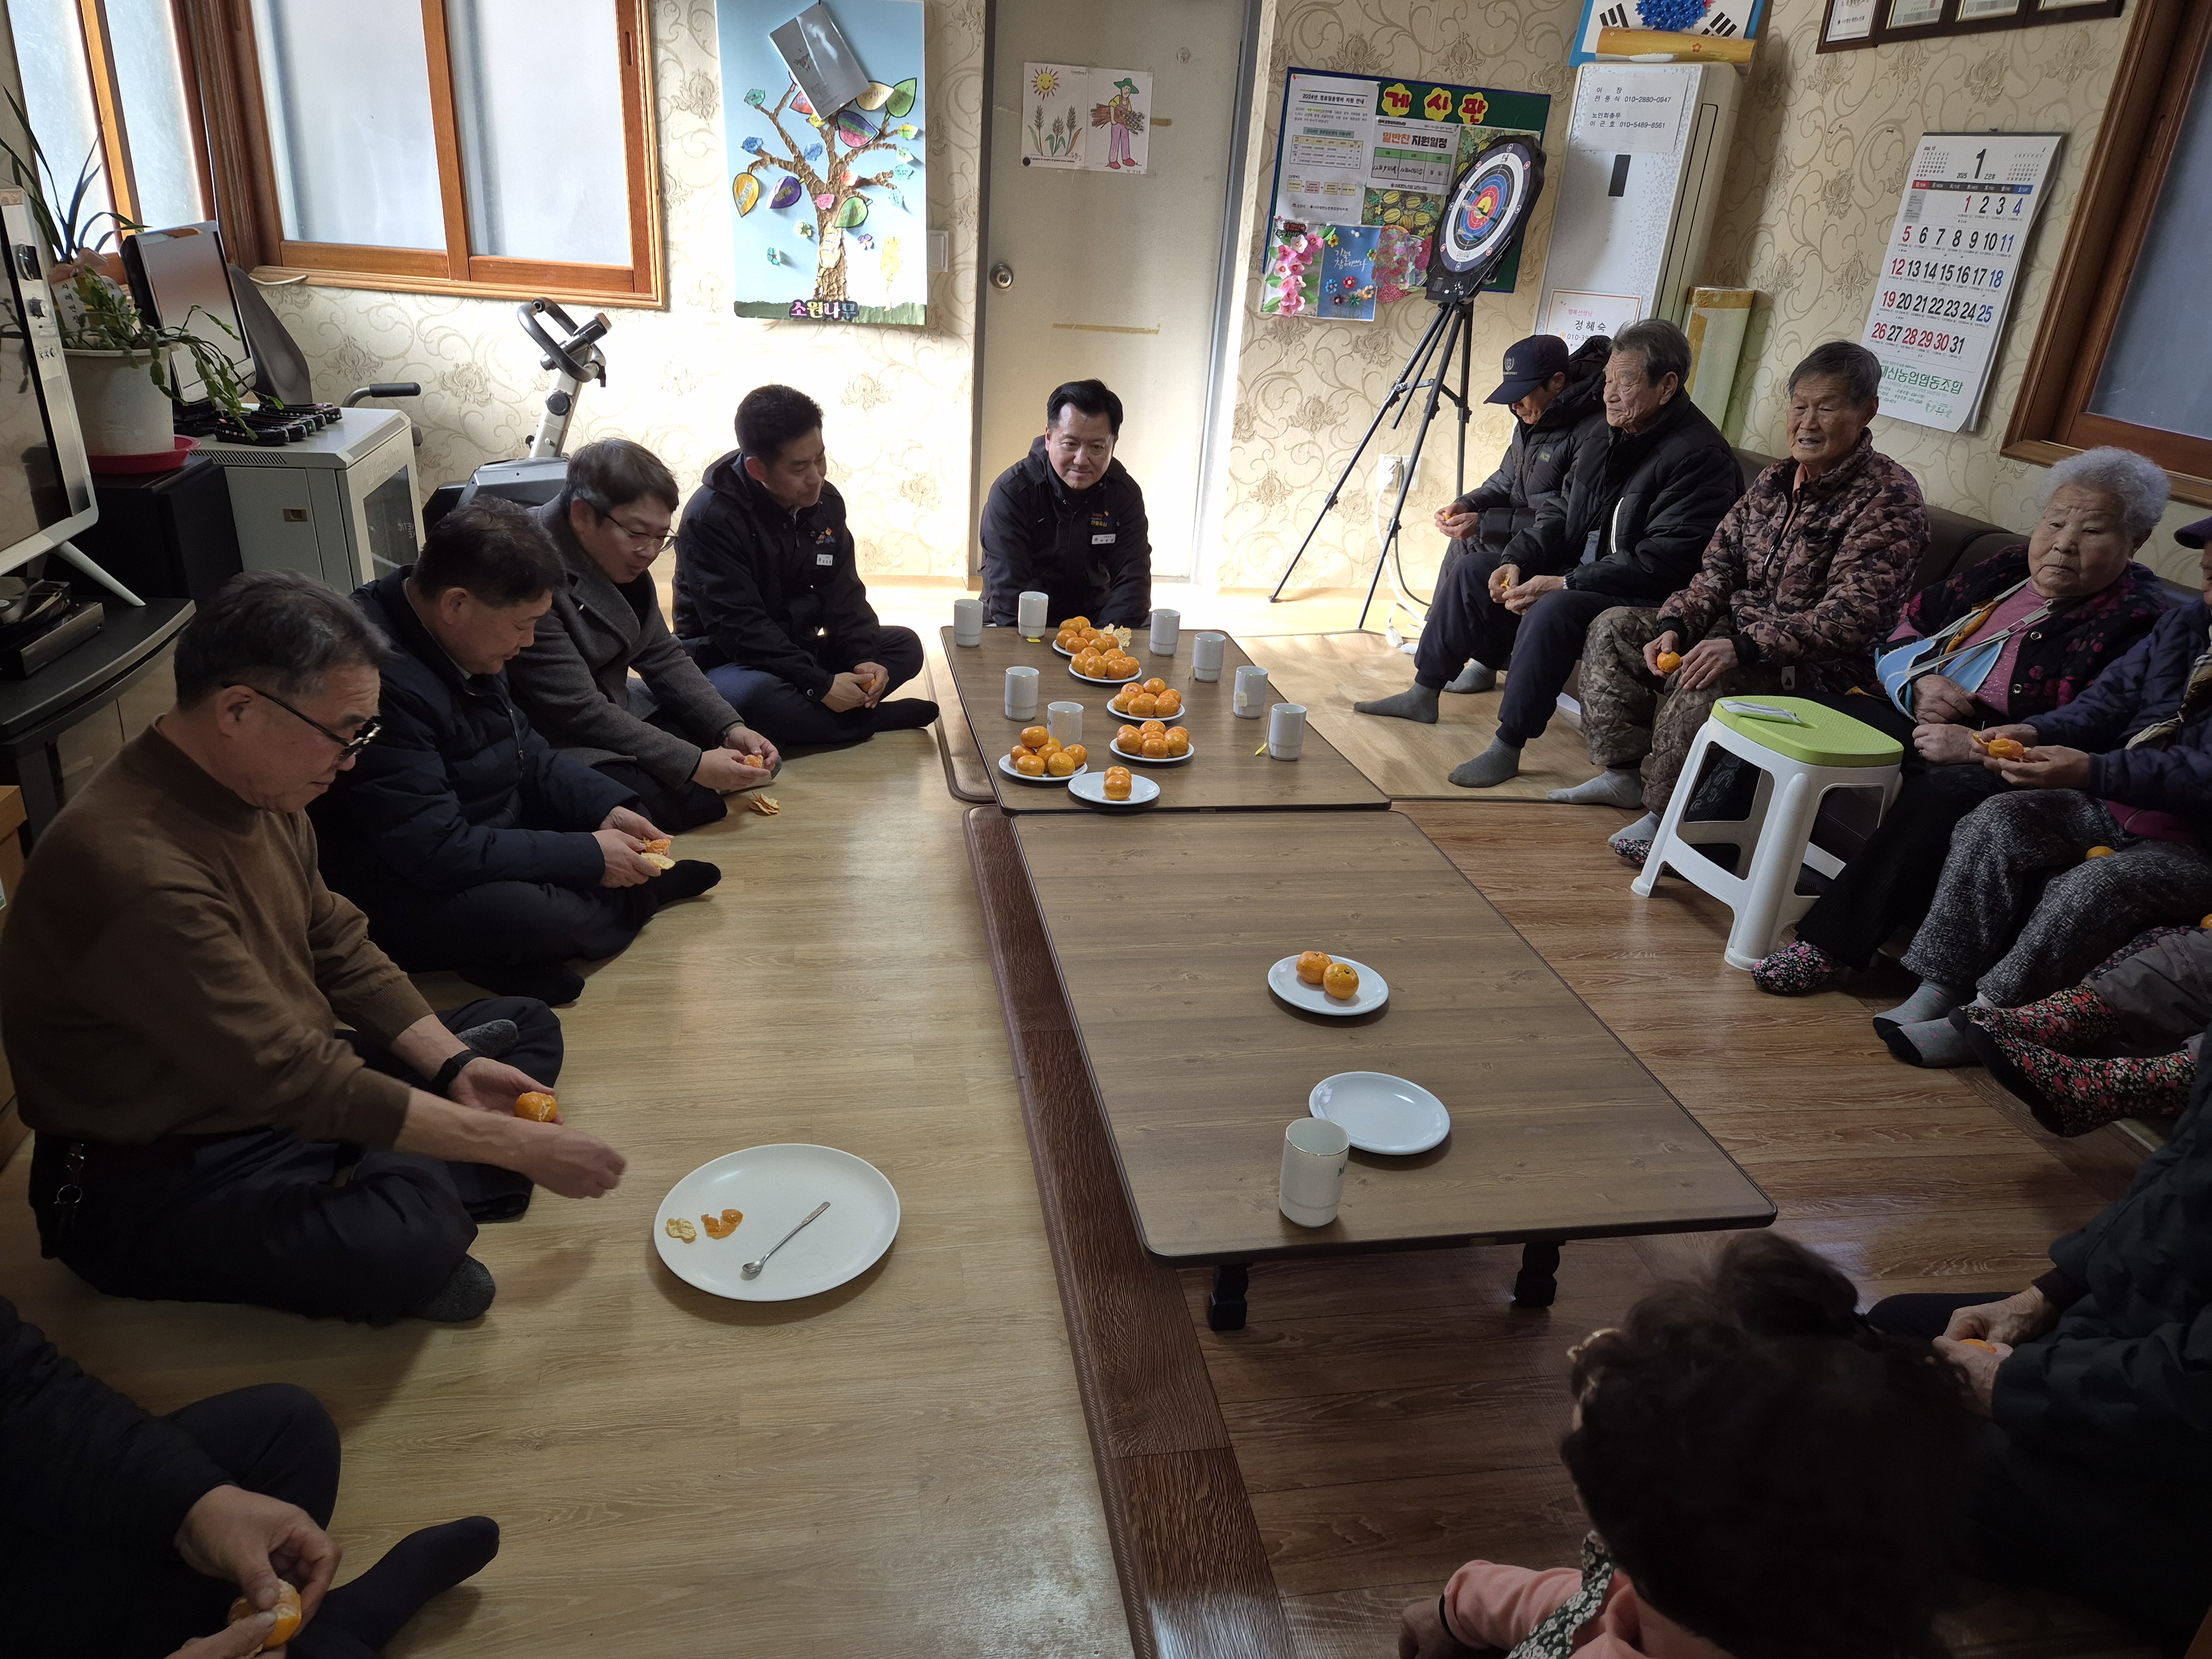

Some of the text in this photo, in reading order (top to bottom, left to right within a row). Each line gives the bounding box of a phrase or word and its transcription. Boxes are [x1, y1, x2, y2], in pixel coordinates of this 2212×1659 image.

[1385, 92, 1485, 123] 게 시 판
[1411, 135, 1448, 149] 지원일정
[1974, 148, 1987, 179] 1
[1964, 195, 2023, 216] 1 2 3 4
[1902, 225, 2015, 252] 5 6 7 8 9 10 11
[1891, 258, 2004, 288] 12 13 14 15 16 17 18
[791, 301, 857, 320] 소원나무
[1568, 309, 1593, 317] 행복선생님
[1882, 290, 1994, 323] 19 20 21 22 23 24 25
[1575, 320, 1606, 332] 정 혜 숙
[1871, 322, 1965, 354] 26 27 28 29 30 31
